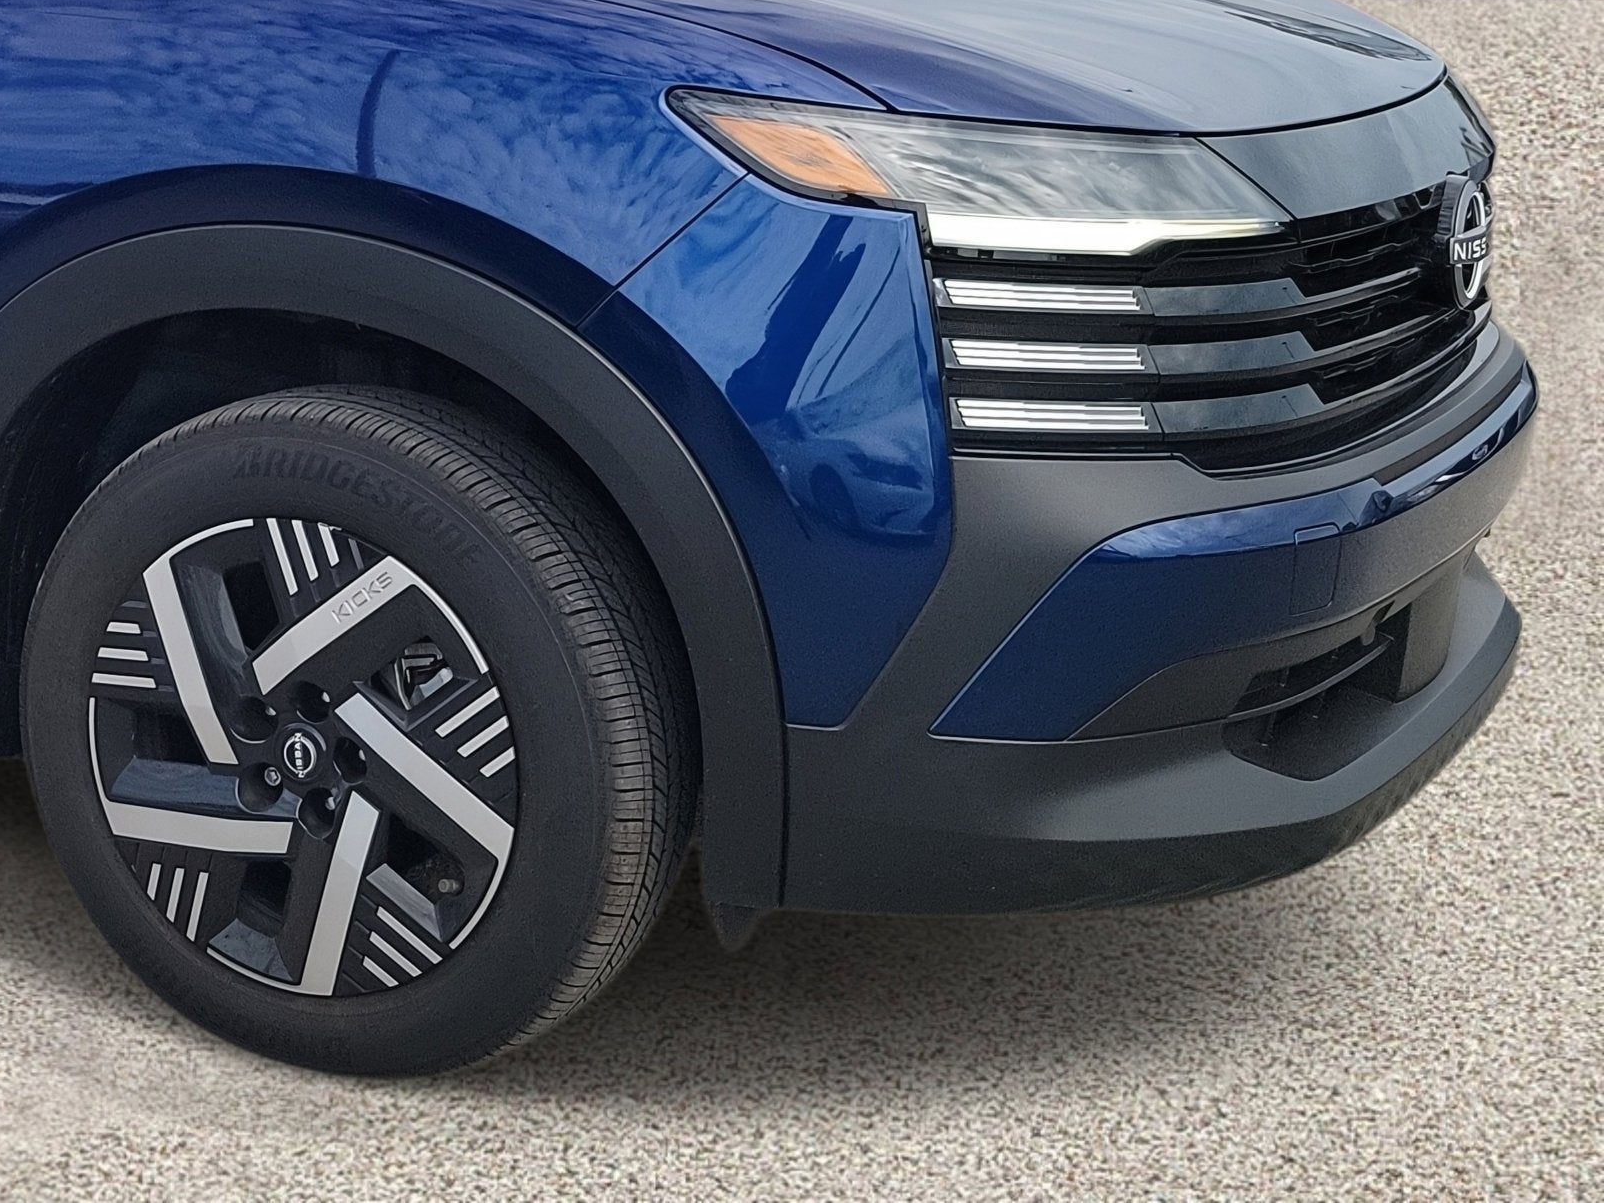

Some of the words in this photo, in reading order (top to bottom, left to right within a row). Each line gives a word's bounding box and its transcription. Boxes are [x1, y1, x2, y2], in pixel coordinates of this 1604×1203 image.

[1454, 237, 1487, 261] NISS
[233, 443, 482, 565] BRIDGESTONE
[331, 571, 394, 624] KICKS
